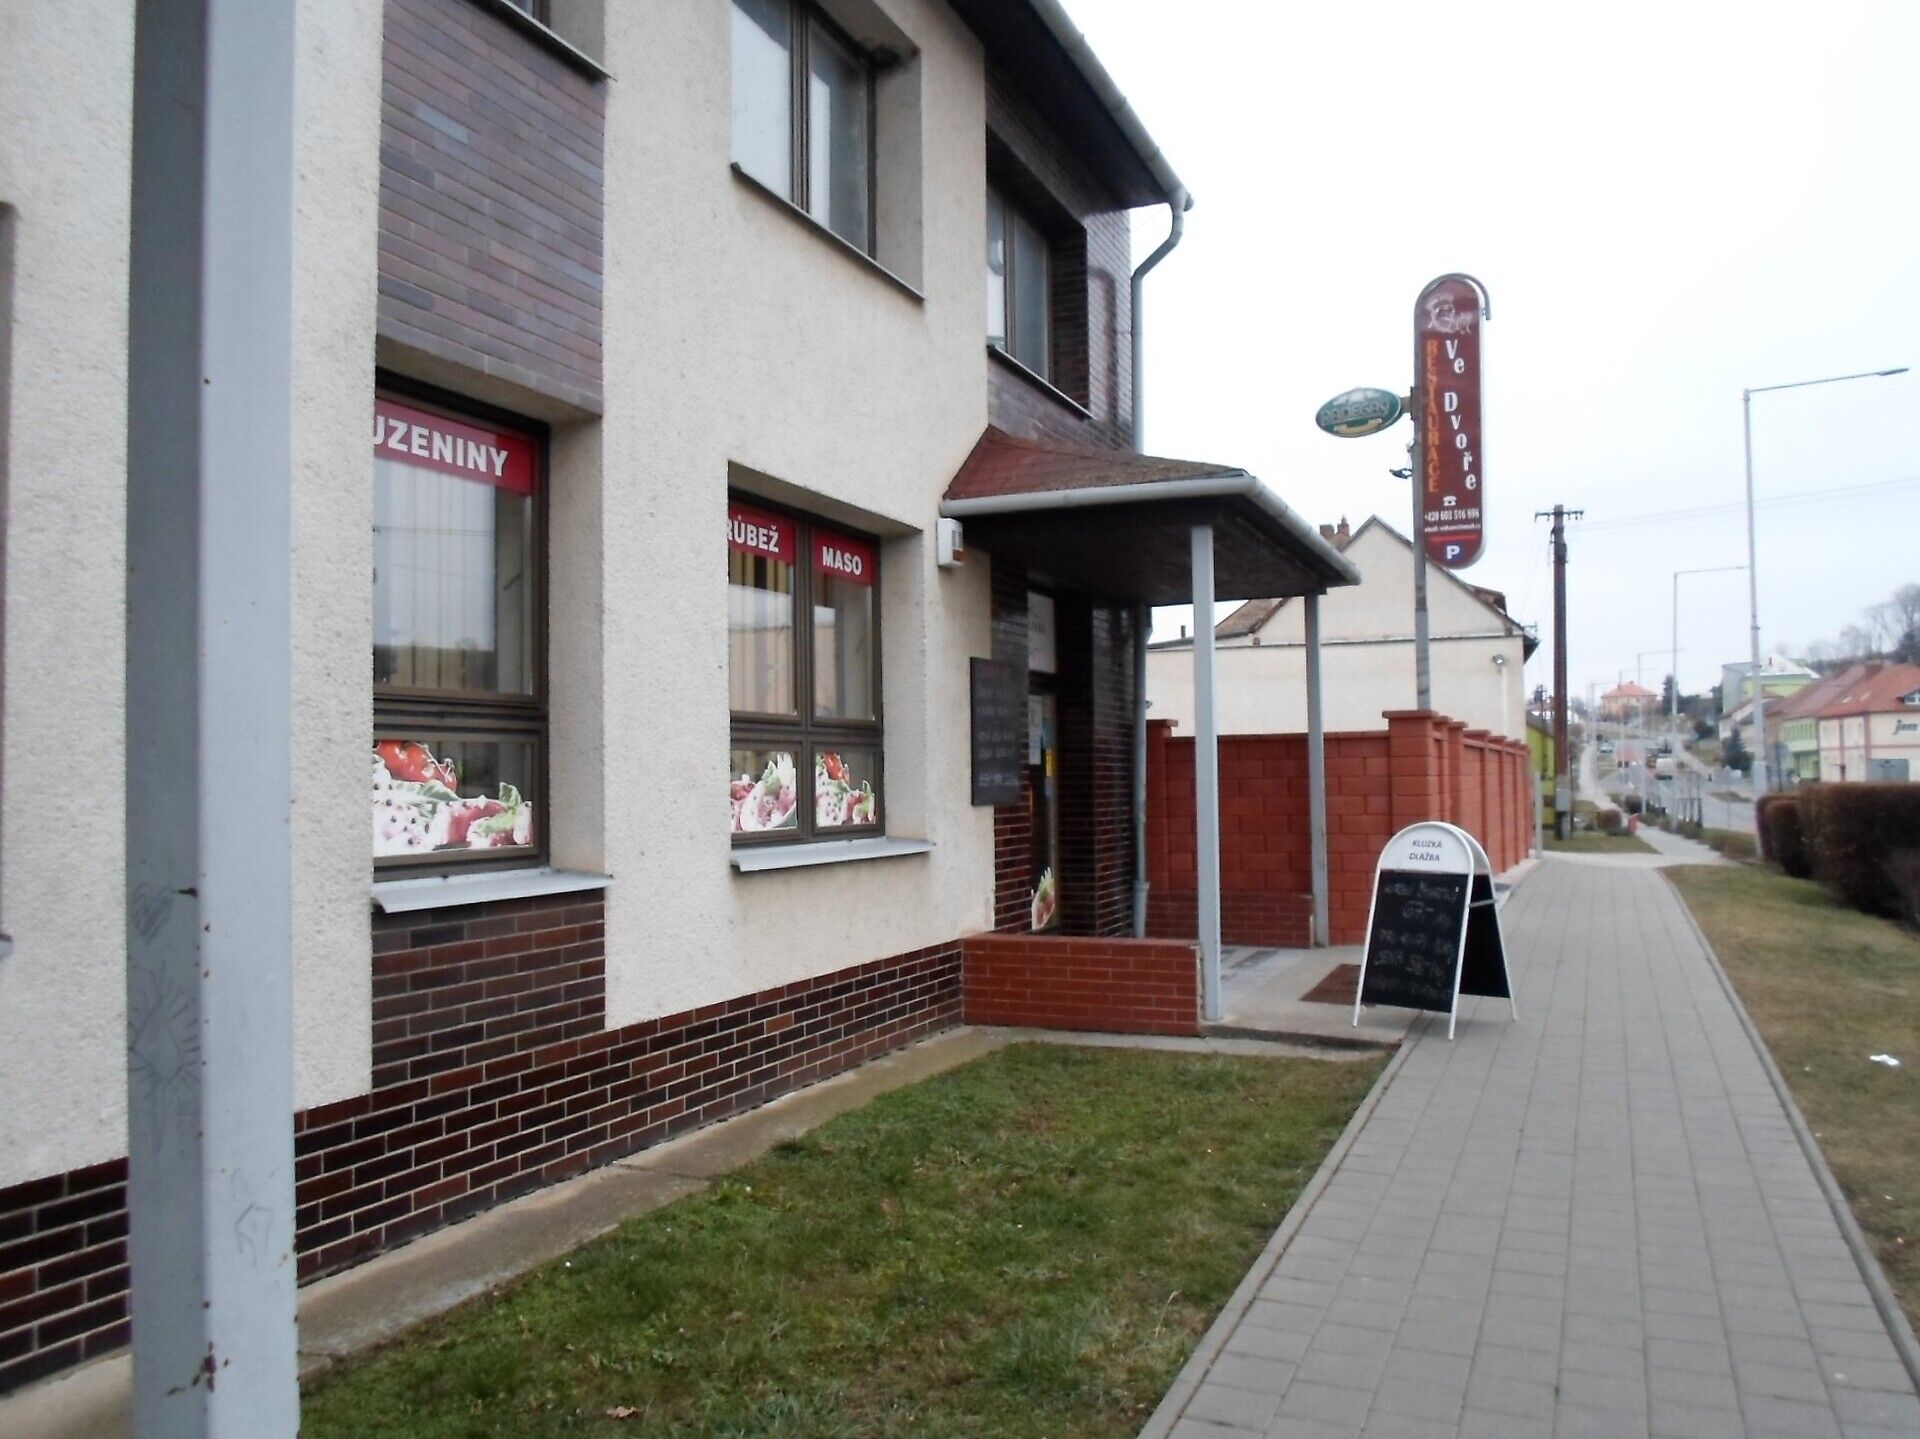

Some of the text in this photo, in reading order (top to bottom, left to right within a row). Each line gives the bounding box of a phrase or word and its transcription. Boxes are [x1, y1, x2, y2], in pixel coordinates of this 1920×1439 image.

[1445, 339, 1466, 375] Ve
[1425, 338, 1440, 493] RESTAURACE
[374, 415, 508, 477] UZENINY
[1443, 391, 1477, 490] Dvoře
[822, 545, 862, 576] MASO
[1446, 545, 1461, 559] P
[1408, 851, 1441, 863] DLAŽBA
